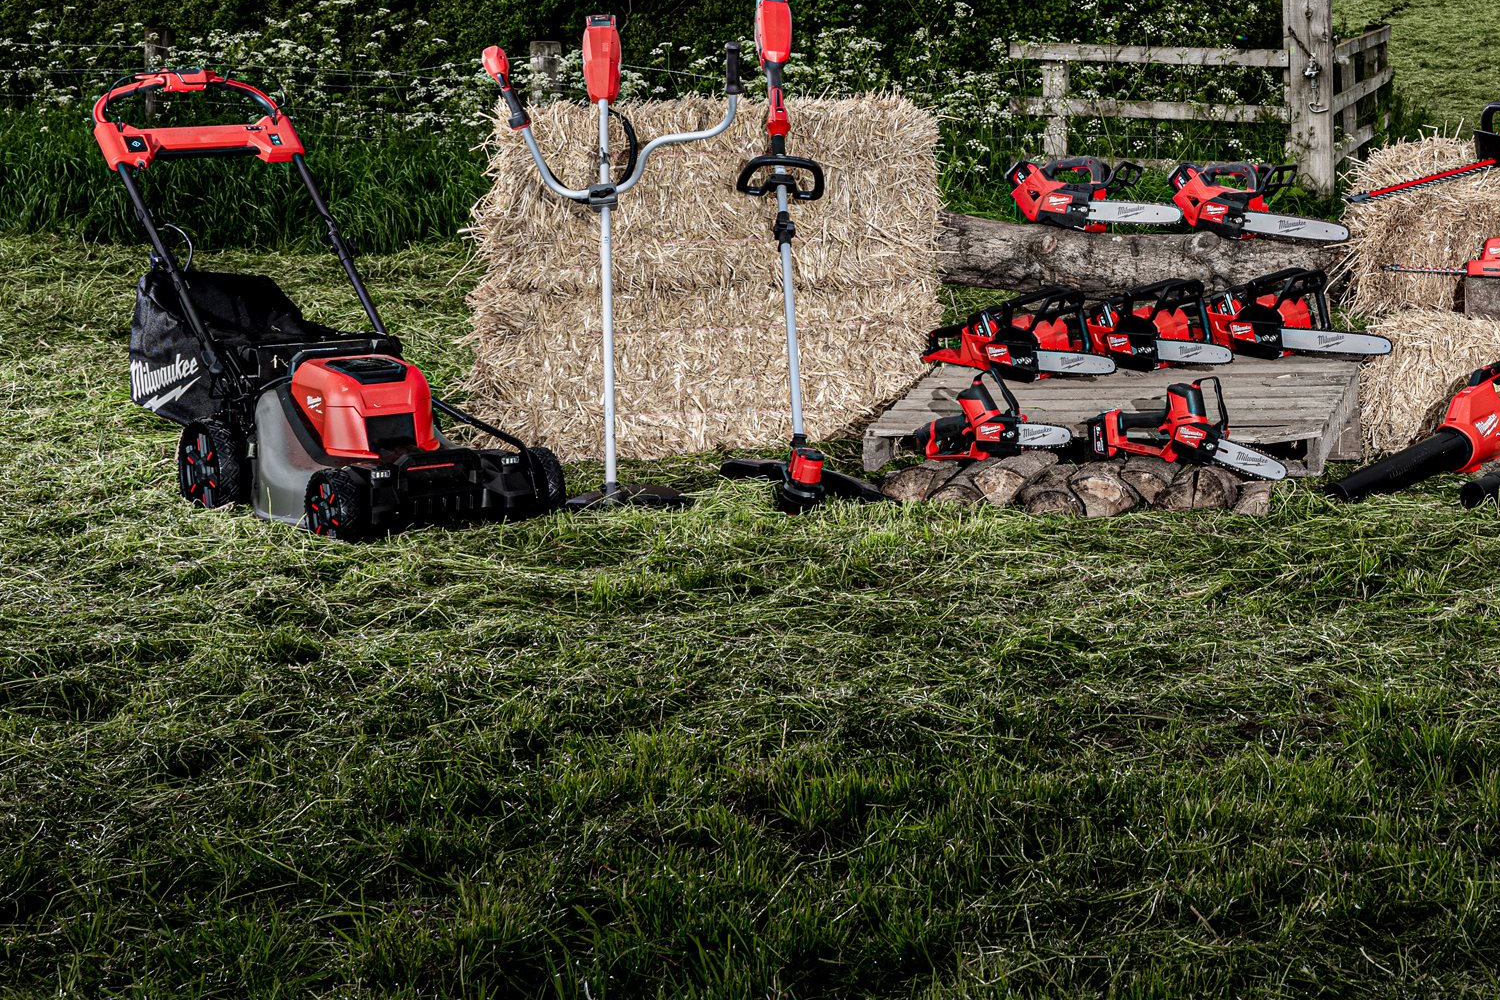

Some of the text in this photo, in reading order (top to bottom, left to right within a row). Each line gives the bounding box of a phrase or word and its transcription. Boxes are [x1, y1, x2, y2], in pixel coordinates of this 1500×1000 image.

[1117, 205, 1145, 215] Milwaukee
[1278, 219, 1306, 229] Milwaukee
[1317, 334, 1345, 345] Milwaukee
[130, 354, 199, 401] Milwaukee
[1022, 427, 1052, 438] Milwaukee
[1235, 451, 1268, 464] Milwaukee
